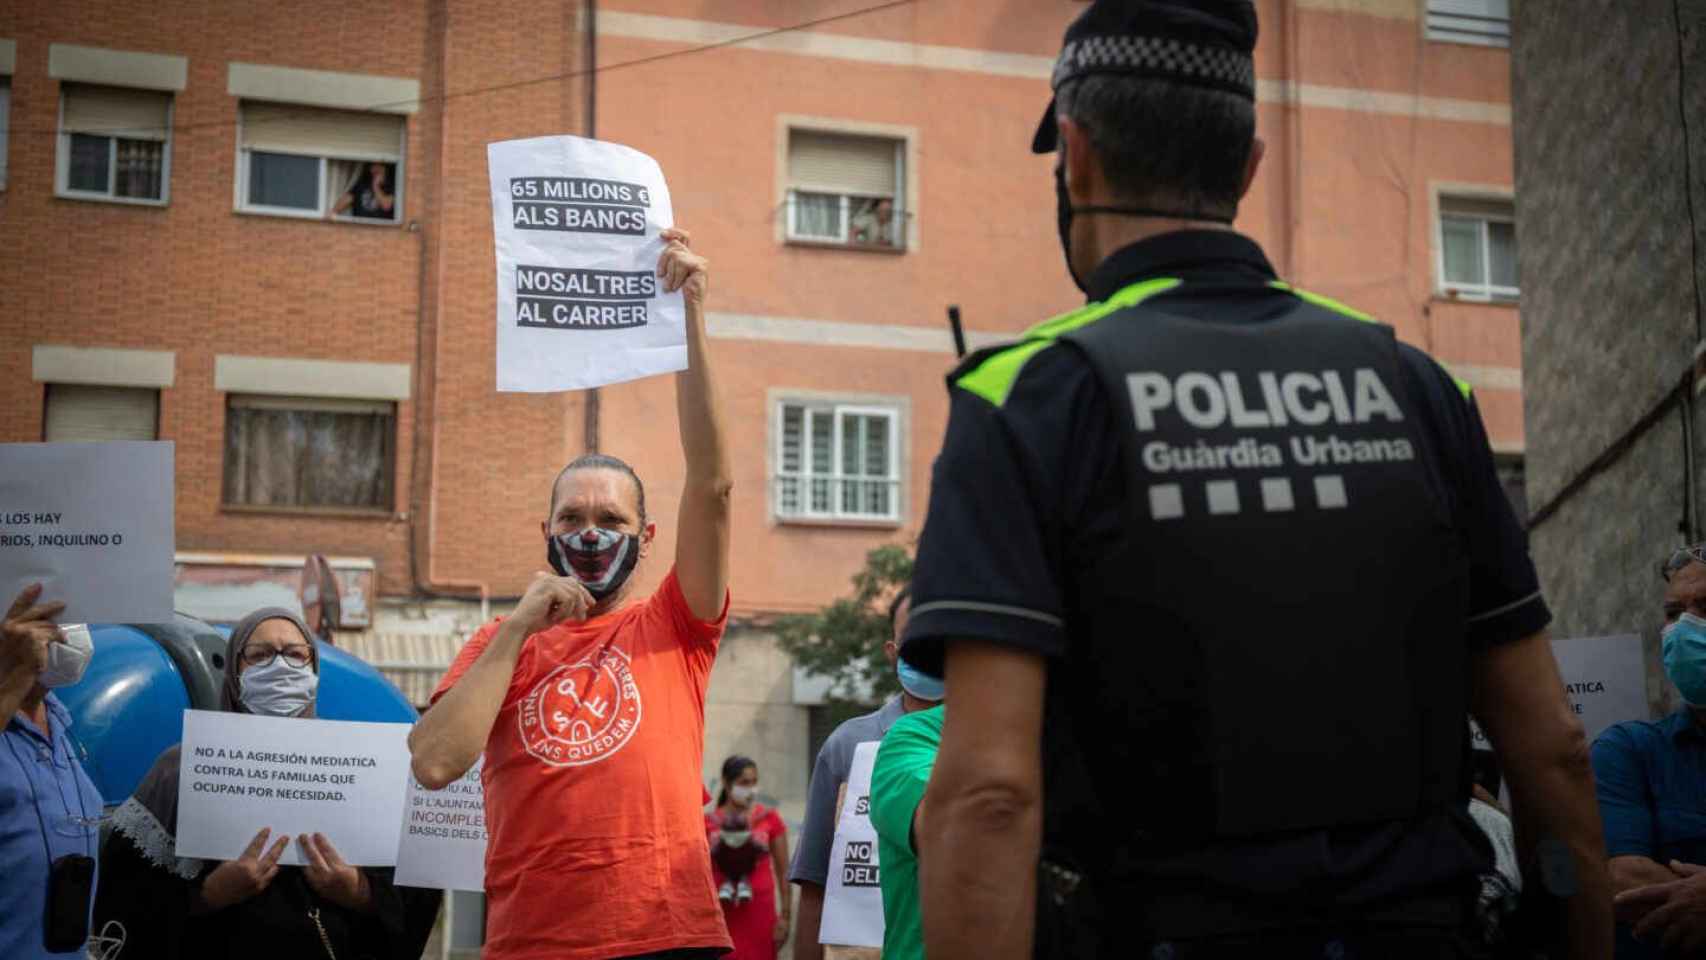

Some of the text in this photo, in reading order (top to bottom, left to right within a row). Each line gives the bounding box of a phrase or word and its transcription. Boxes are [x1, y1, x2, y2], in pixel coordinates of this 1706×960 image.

[511, 180, 650, 204] 65 MILIONS €
[513, 206, 645, 231] ALS BANCS
[517, 269, 655, 296] NOSALTRES
[517, 302, 647, 326] AL CARRER
[1125, 368, 1404, 431] POLICIA
[1142, 435, 1414, 473] Guàrdia Urbana
[6, 512, 31, 525] LOS
[34, 512, 62, 524] HAY
[38, 534, 109, 547] INQUILINO
[112, 534, 122, 545] O
[567, 718, 633, 759] QUEDEM
[194, 746, 377, 768] NO A LA AGRESIÓN MEDIATICA
[194, 764, 357, 785] CONTRA LAS FAMILIAS QUE
[193, 781, 348, 802] OCUPAN POR NECESIDAD.
[411, 810, 484, 827] INCOMPLE
[845, 844, 870, 860] NO
